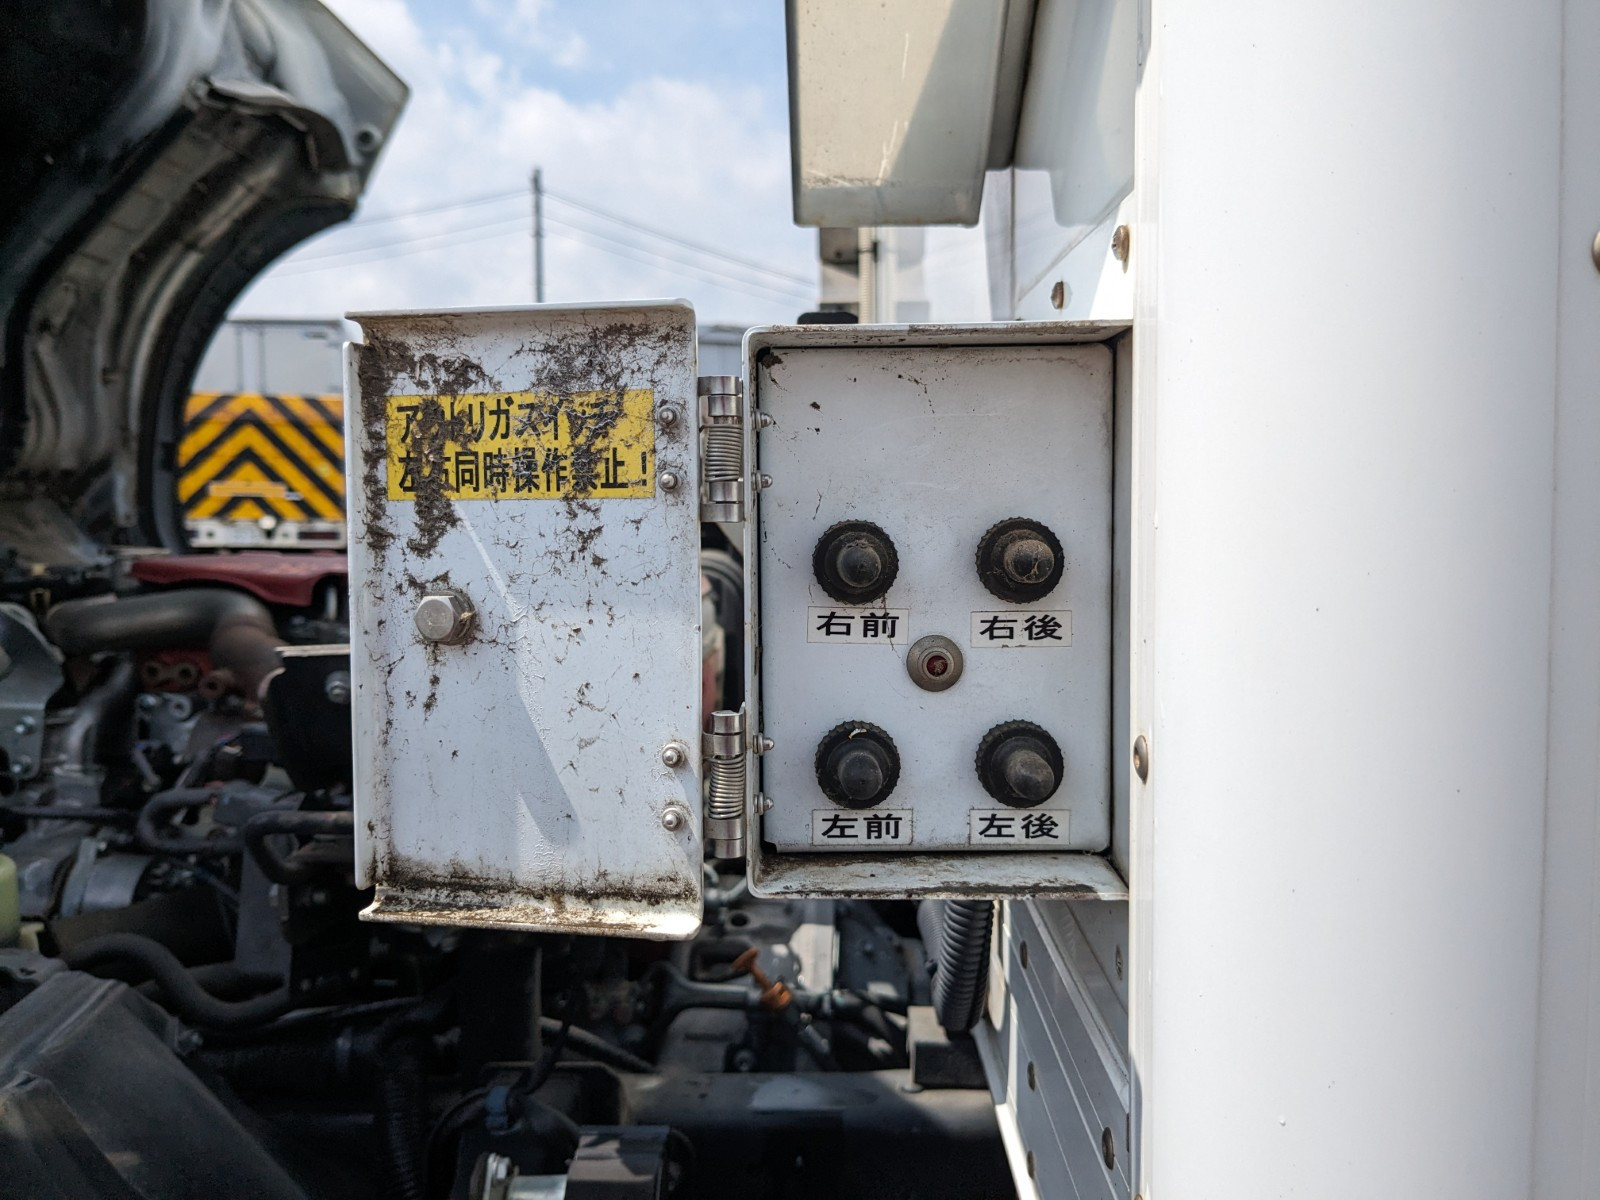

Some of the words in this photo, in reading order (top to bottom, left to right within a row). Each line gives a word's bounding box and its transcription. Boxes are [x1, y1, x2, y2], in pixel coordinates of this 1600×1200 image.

[397, 396, 622, 443] アトリガスイッチ
[398, 447, 647, 493] 左同時操作禁止！
[816, 611, 900, 638] 右前
[979, 614, 1063, 641] 右後
[821, 813, 903, 840] 左前
[978, 813, 1059, 839] 左後
